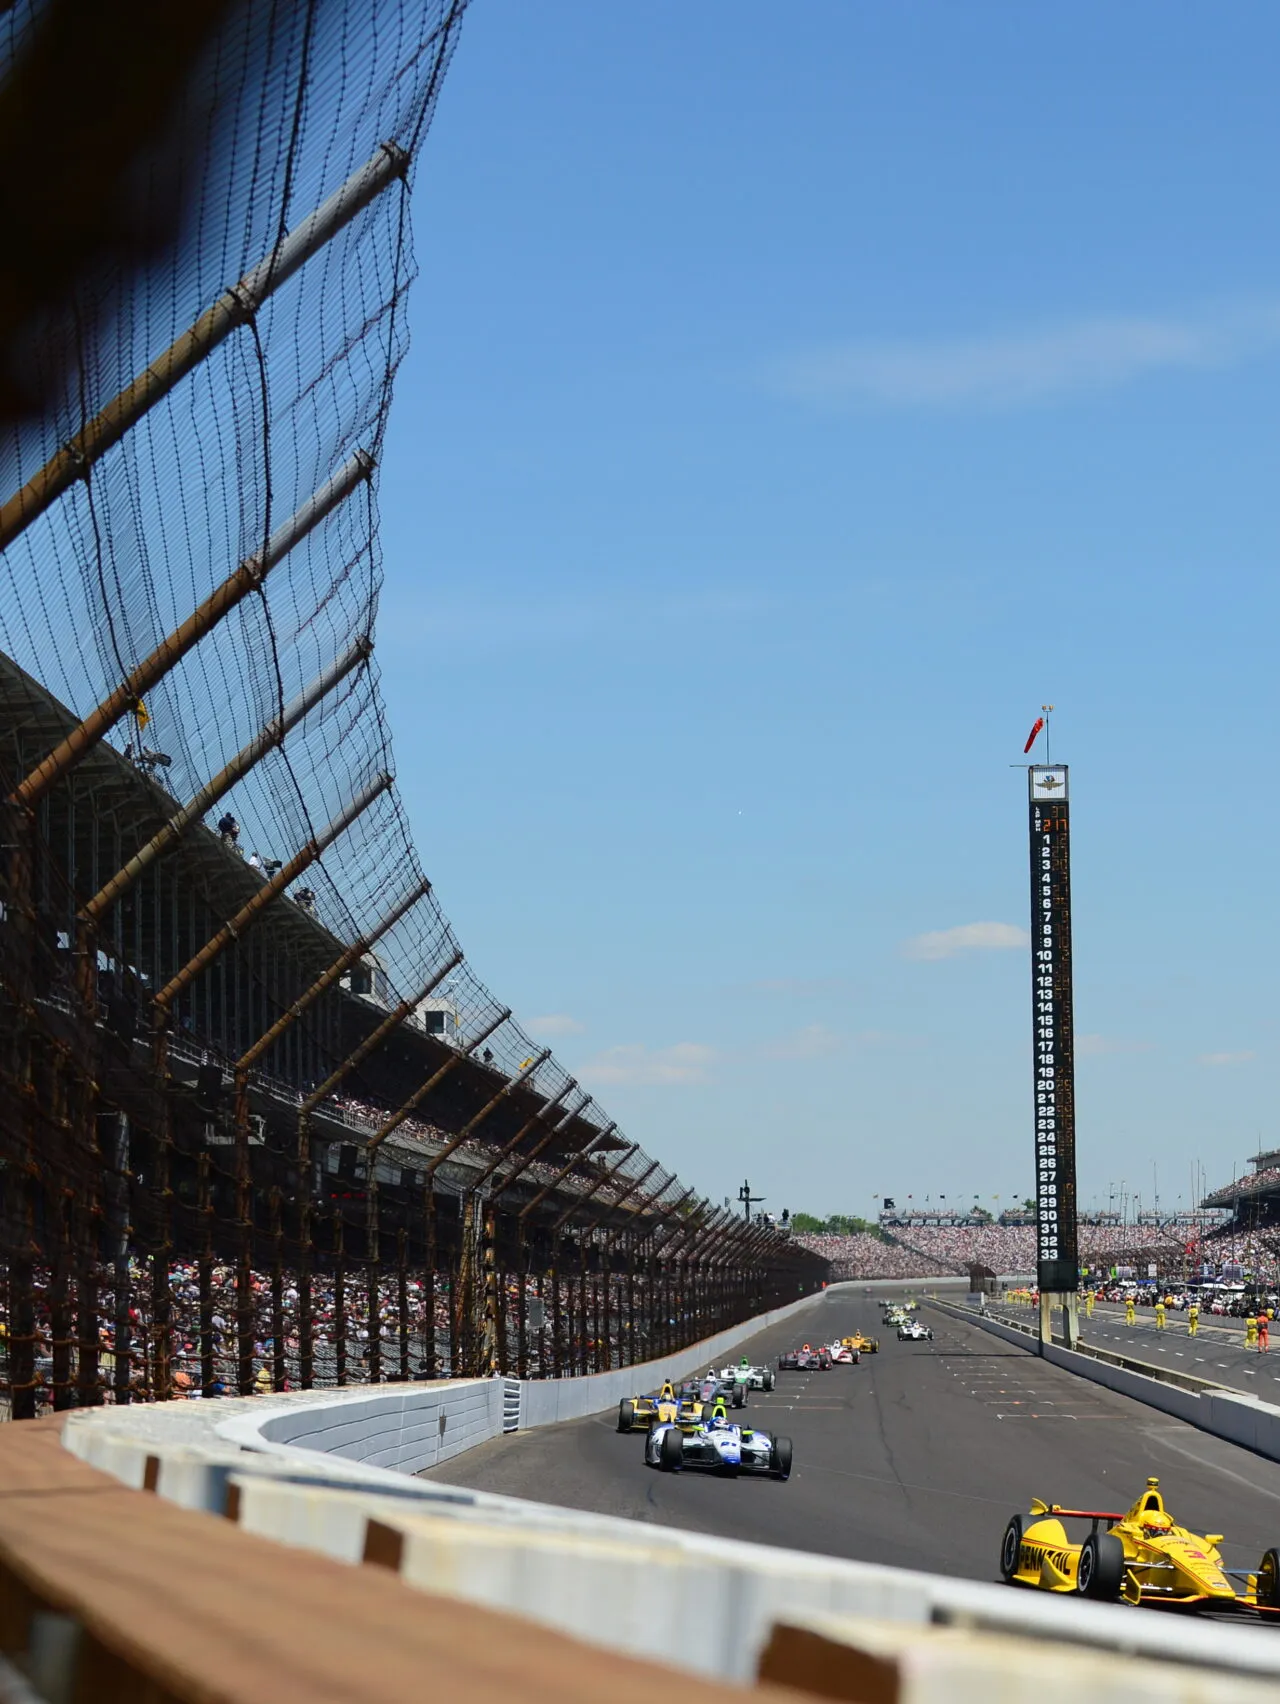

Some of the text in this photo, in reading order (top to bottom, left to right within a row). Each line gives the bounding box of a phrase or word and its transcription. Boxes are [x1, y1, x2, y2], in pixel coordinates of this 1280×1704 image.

[1043, 834, 1050, 844] 1
[1042, 847, 1050, 857] 2
[1042, 860, 1051, 870] 3
[1042, 873, 1051, 883] 4
[1043, 886, 1051, 896] 5
[1043, 898, 1051, 909] 6
[1043, 912, 1051, 922] 7
[1043, 925, 1052, 934] 8
[1043, 938, 1052, 947] 9
[1037, 951, 1052, 960] 10
[1038, 964, 1052, 973] 11
[1037, 977, 1052, 986] 12
[1037, 989, 1053, 999] 13
[1037, 1002, 1053, 1012] 14
[1037, 1015, 1053, 1025] 15
[1038, 1028, 1053, 1038] 16
[1038, 1041, 1053, 1051] 17
[1038, 1054, 1054, 1064] 18
[1038, 1067, 1054, 1077] 19
[1038, 1080, 1054, 1090] 20
[1038, 1093, 1055, 1103] 21
[1039, 1106, 1055, 1116] 22
[1038, 1119, 1055, 1129] 23
[1038, 1132, 1055, 1142] 24
[1039, 1145, 1056, 1155] 25
[1040, 1158, 1056, 1168] 26
[1040, 1171, 1056, 1181] 27
[1040, 1184, 1056, 1195] 28
[1040, 1197, 1056, 1207] 29
[1040, 1210, 1057, 1220] 30
[1041, 1223, 1058, 1233] 31
[1041, 1236, 1058, 1246] 32
[1041, 1249, 1058, 1259] 33
